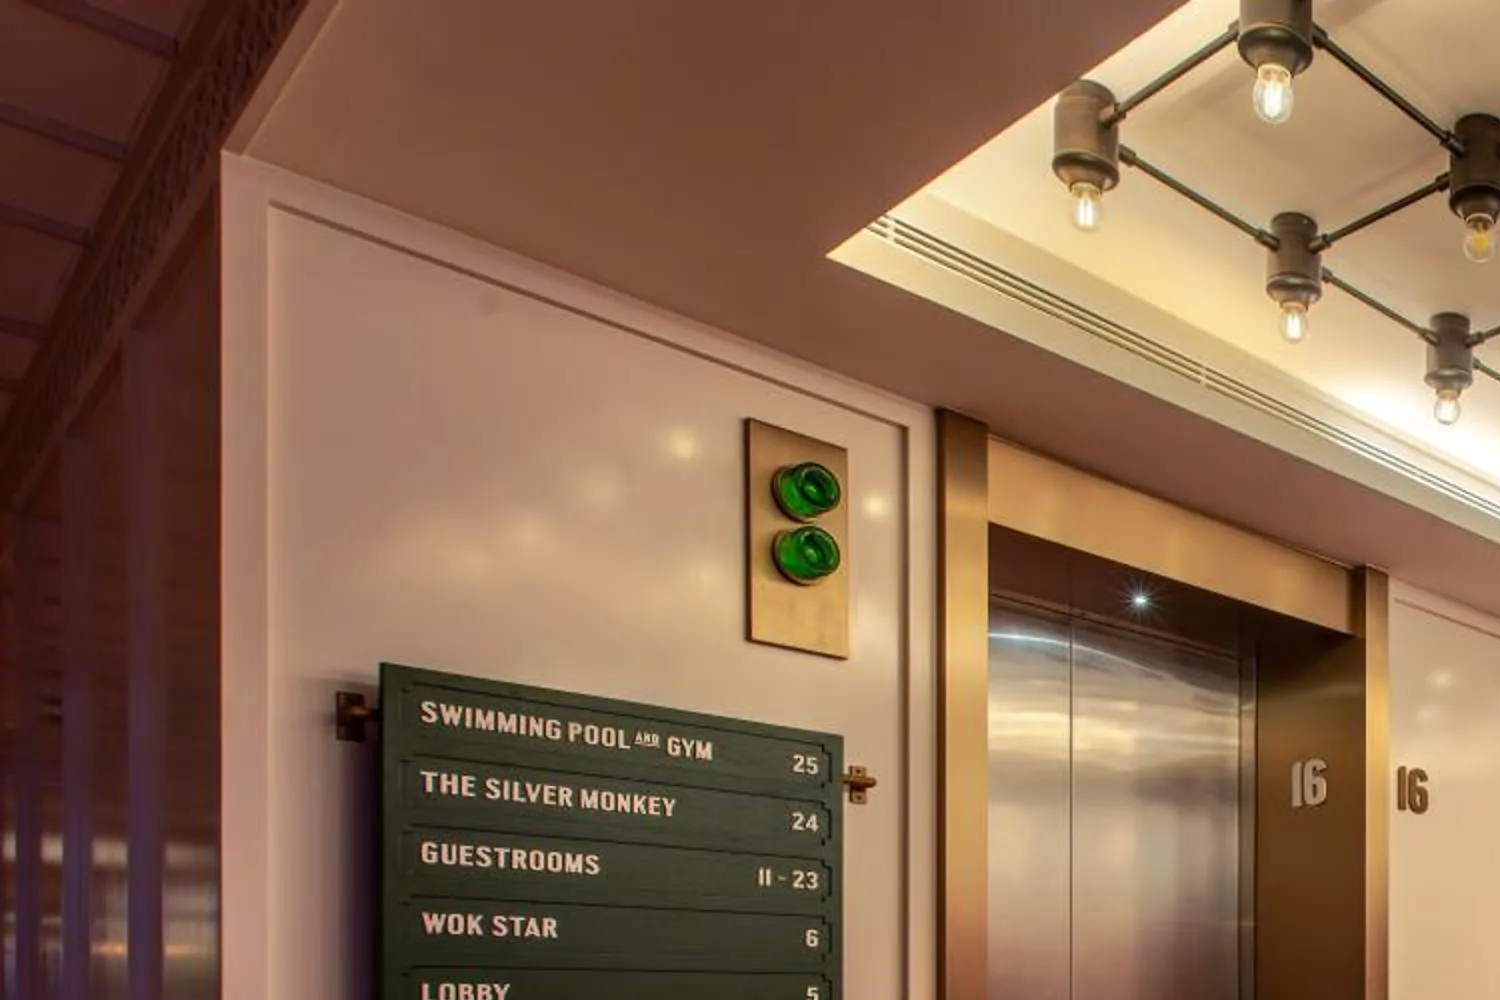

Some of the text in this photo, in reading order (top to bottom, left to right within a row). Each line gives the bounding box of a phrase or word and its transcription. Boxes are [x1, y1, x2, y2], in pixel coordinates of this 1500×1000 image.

[421, 701, 562, 741] SWIMMING
[568, 721, 631, 750] POOL
[667, 735, 713, 761] GYM
[792, 753, 819, 775] 25
[420, 770, 819, 832] THE SILVER MONKEY 24
[1291, 758, 1327, 808] 16
[1396, 765, 1429, 815] 16
[421, 841, 601, 875] GUESTROOMS
[758, 867, 772, 887] 11
[792, 869, 819, 890] 23
[422, 912, 819, 948] WOK STAR 6
